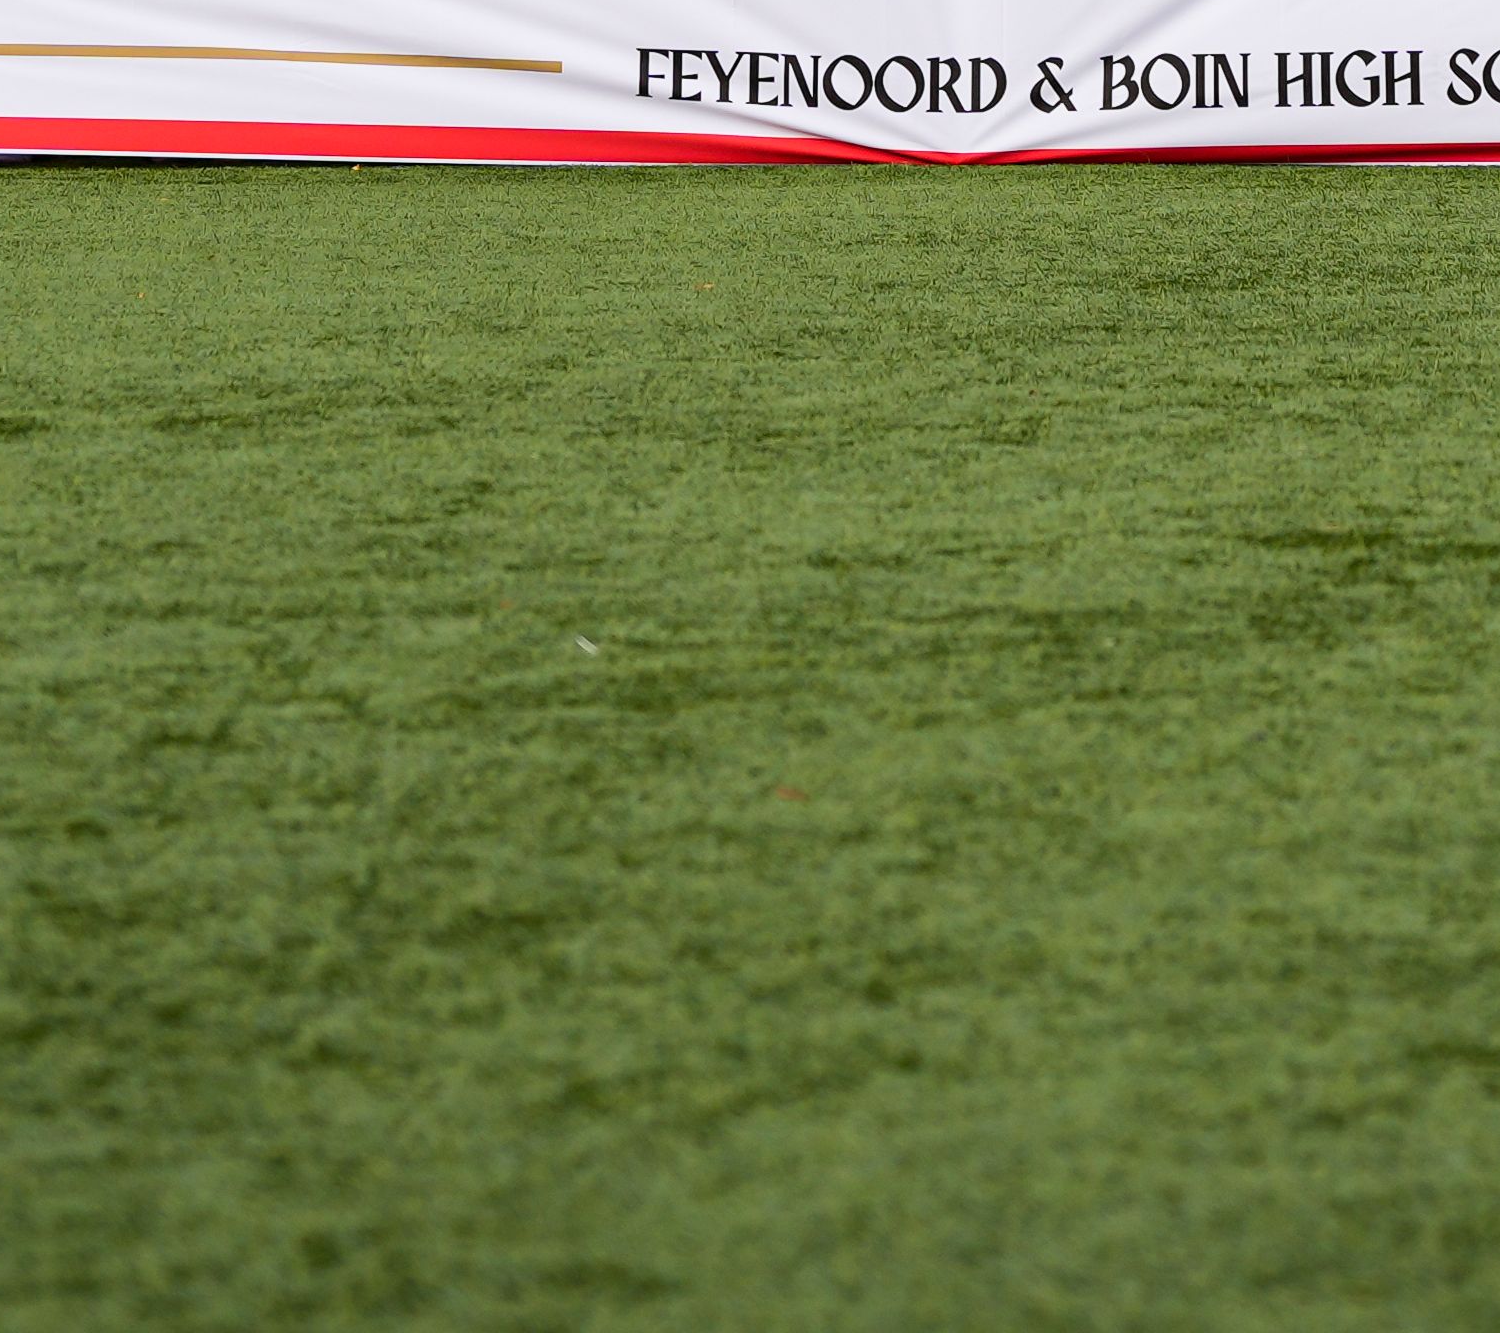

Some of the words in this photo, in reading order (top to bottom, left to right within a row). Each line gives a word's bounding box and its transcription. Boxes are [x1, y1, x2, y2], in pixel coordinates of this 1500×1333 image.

[636, 48, 1008, 114] FEYENOORD
[1030, 55, 1078, 113] &
[1100, 52, 1250, 111] BOIN
[1275, 49, 1424, 107] HIGH
